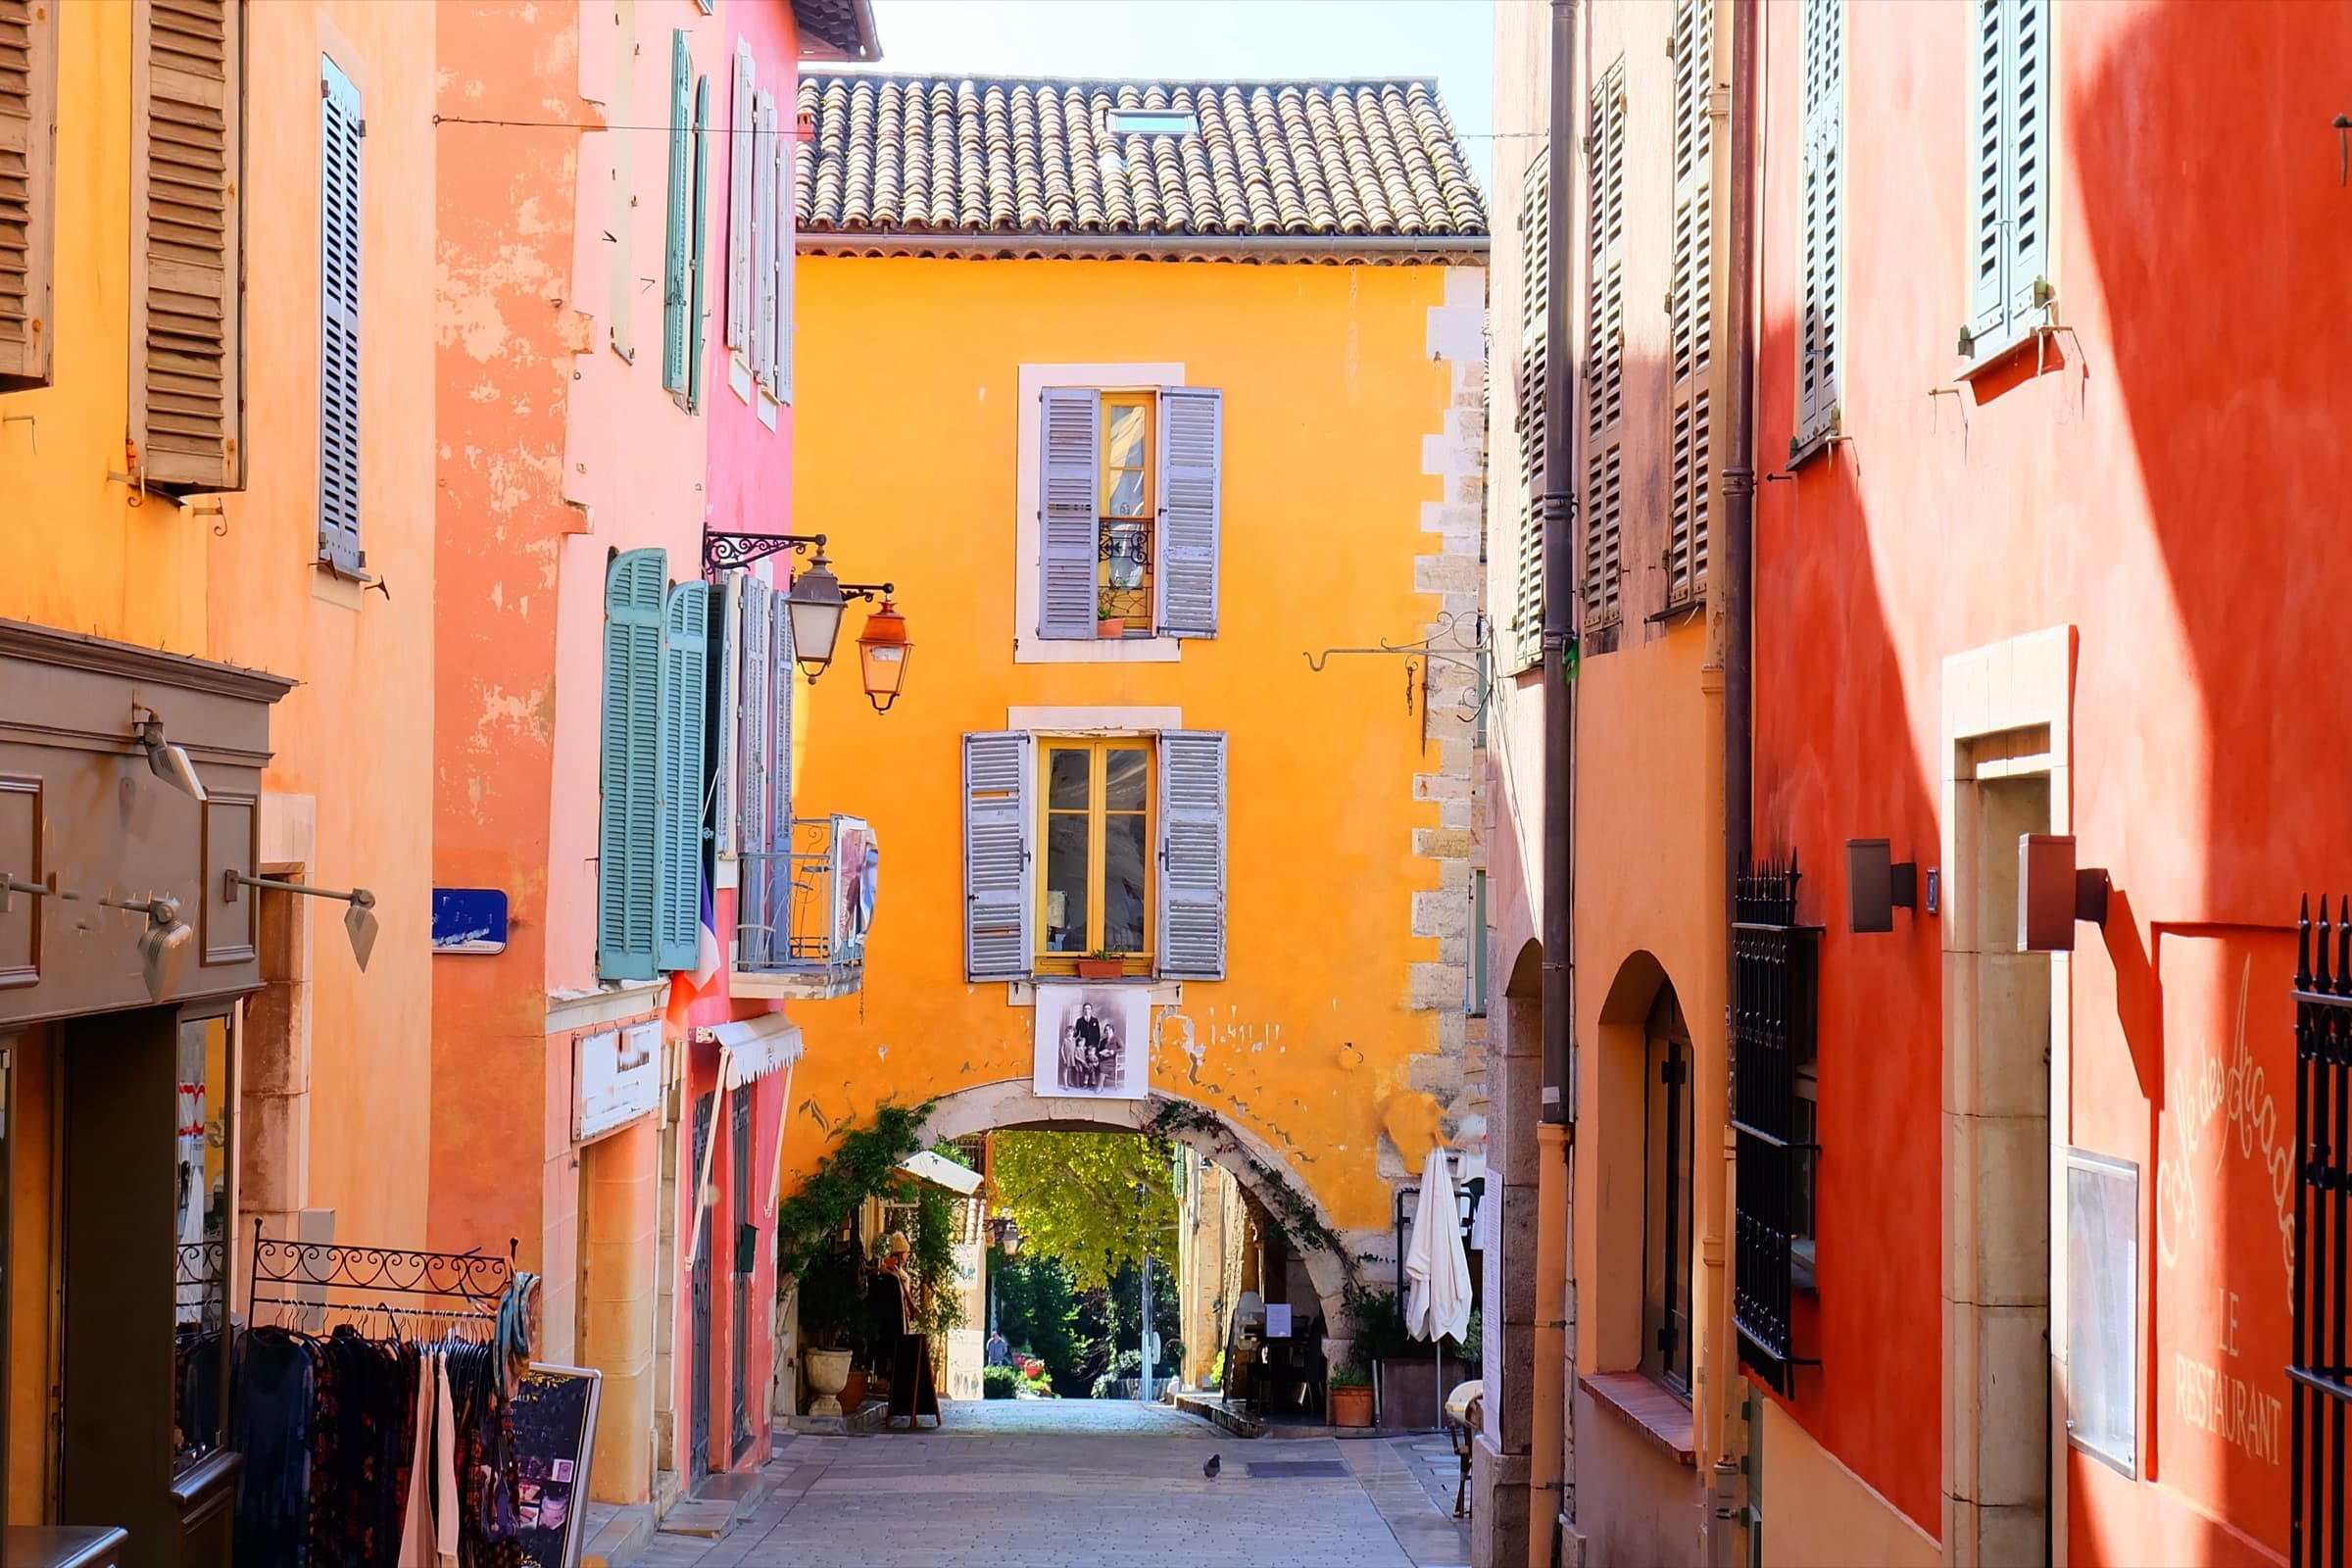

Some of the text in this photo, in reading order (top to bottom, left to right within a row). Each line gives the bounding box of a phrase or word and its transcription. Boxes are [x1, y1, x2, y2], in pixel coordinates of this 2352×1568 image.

[2199, 1038, 2225, 1126] des
[2214, 952, 2295, 1316] Arcade
[2218, 1287, 2239, 1357] LE
[2176, 1353, 2281, 1466] RESTAURANT
